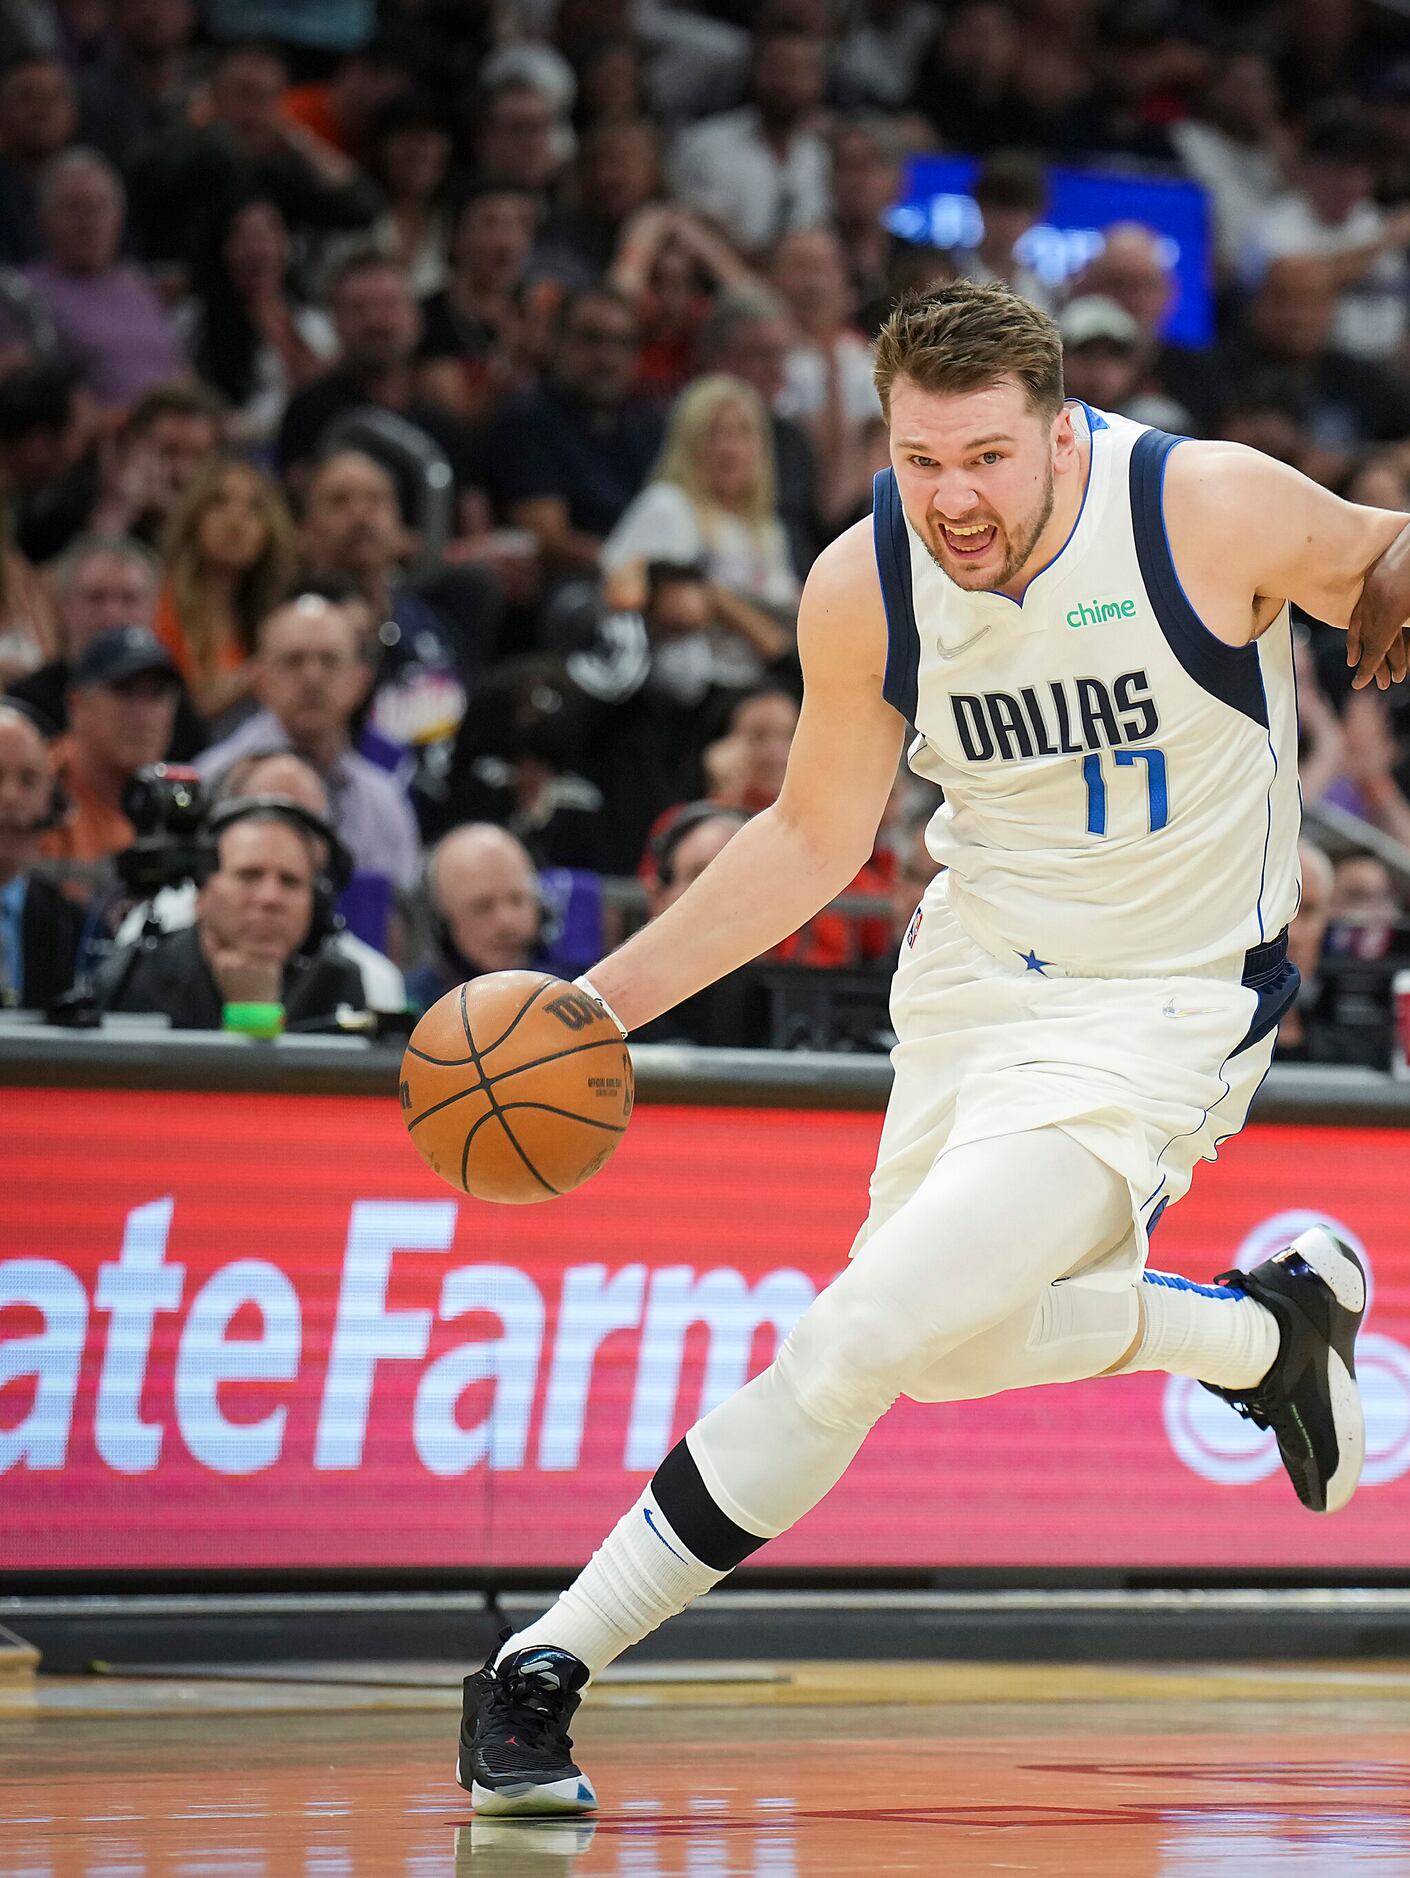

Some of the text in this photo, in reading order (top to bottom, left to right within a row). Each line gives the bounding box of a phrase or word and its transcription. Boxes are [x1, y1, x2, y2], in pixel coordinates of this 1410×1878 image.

[1066, 599, 1137, 628] chime
[948, 667, 1162, 762] DALLAS
[1081, 745, 1171, 838] 17
